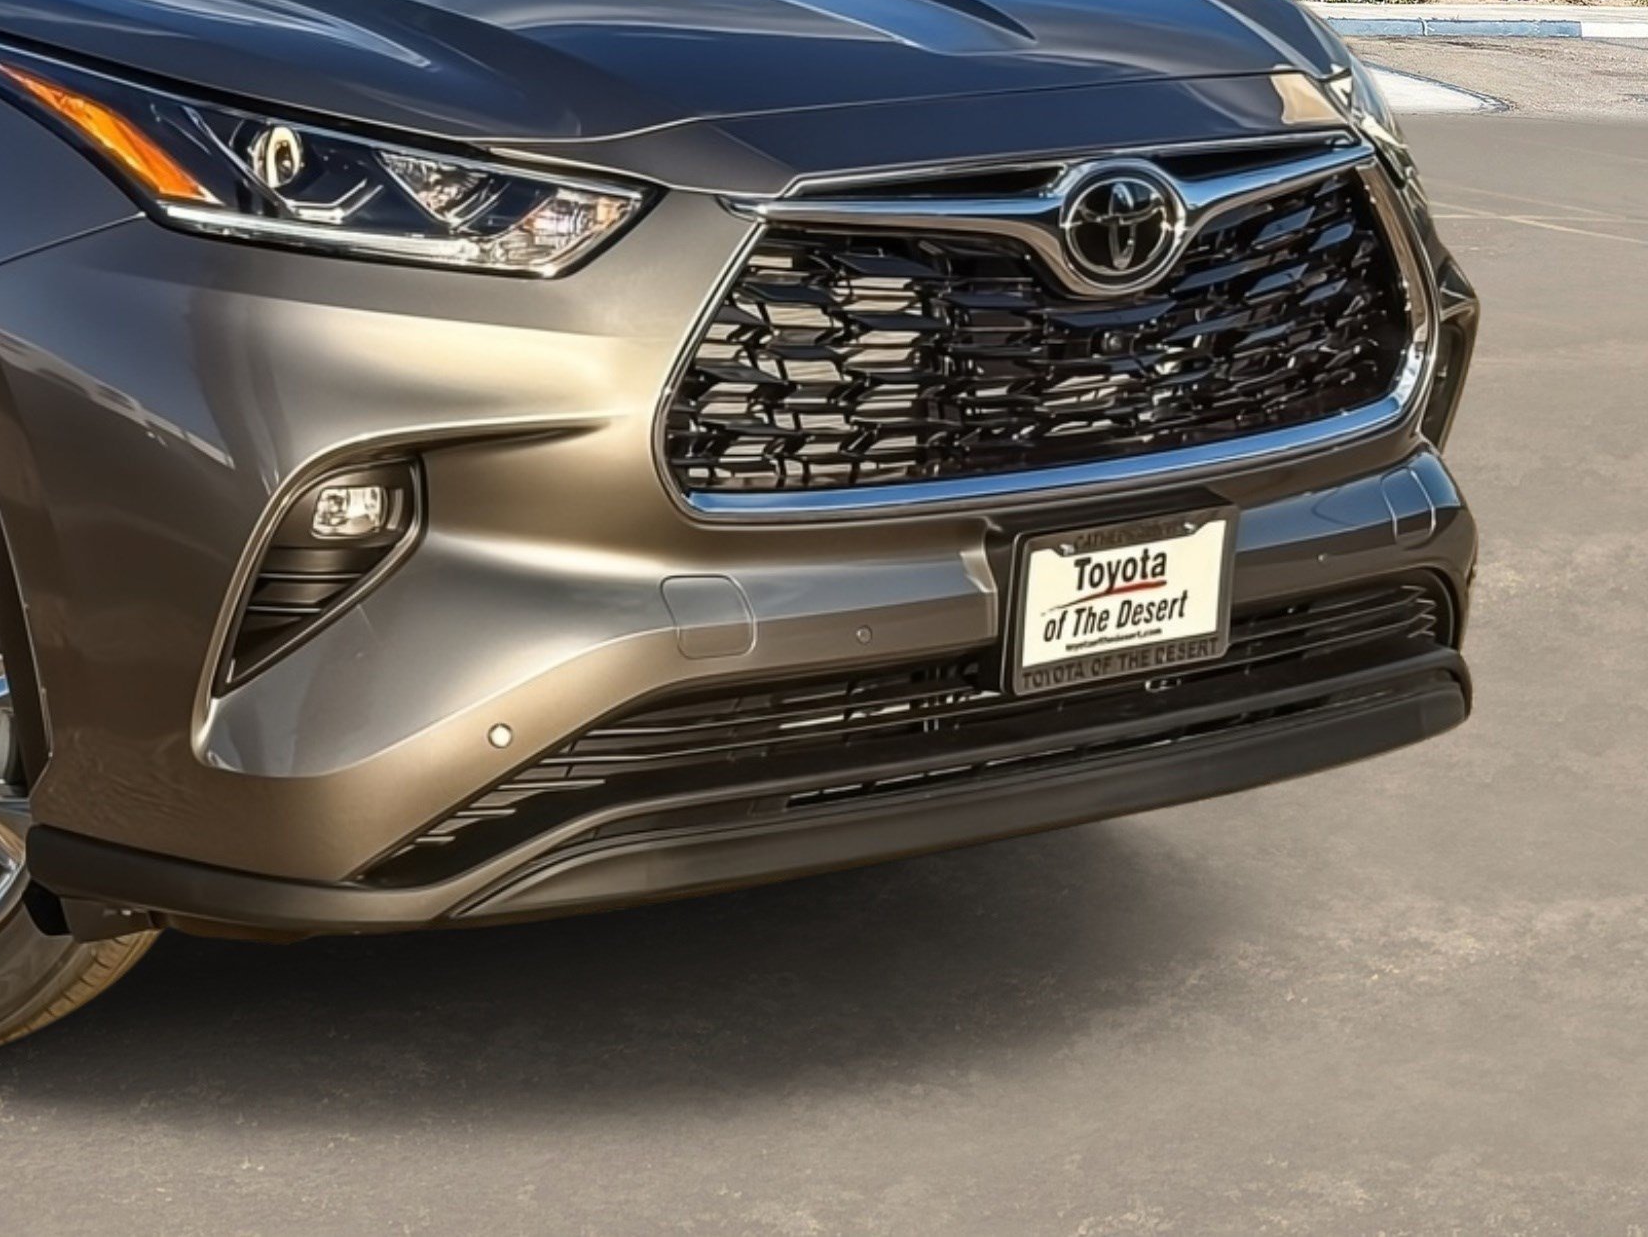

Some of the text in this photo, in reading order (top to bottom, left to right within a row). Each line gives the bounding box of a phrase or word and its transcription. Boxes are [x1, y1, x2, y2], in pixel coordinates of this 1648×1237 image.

[1074, 548, 1167, 593] Toyota
[1043, 590, 1188, 642] of The Desert
[1022, 637, 1219, 690] TOYOTA OF THE DESERT
